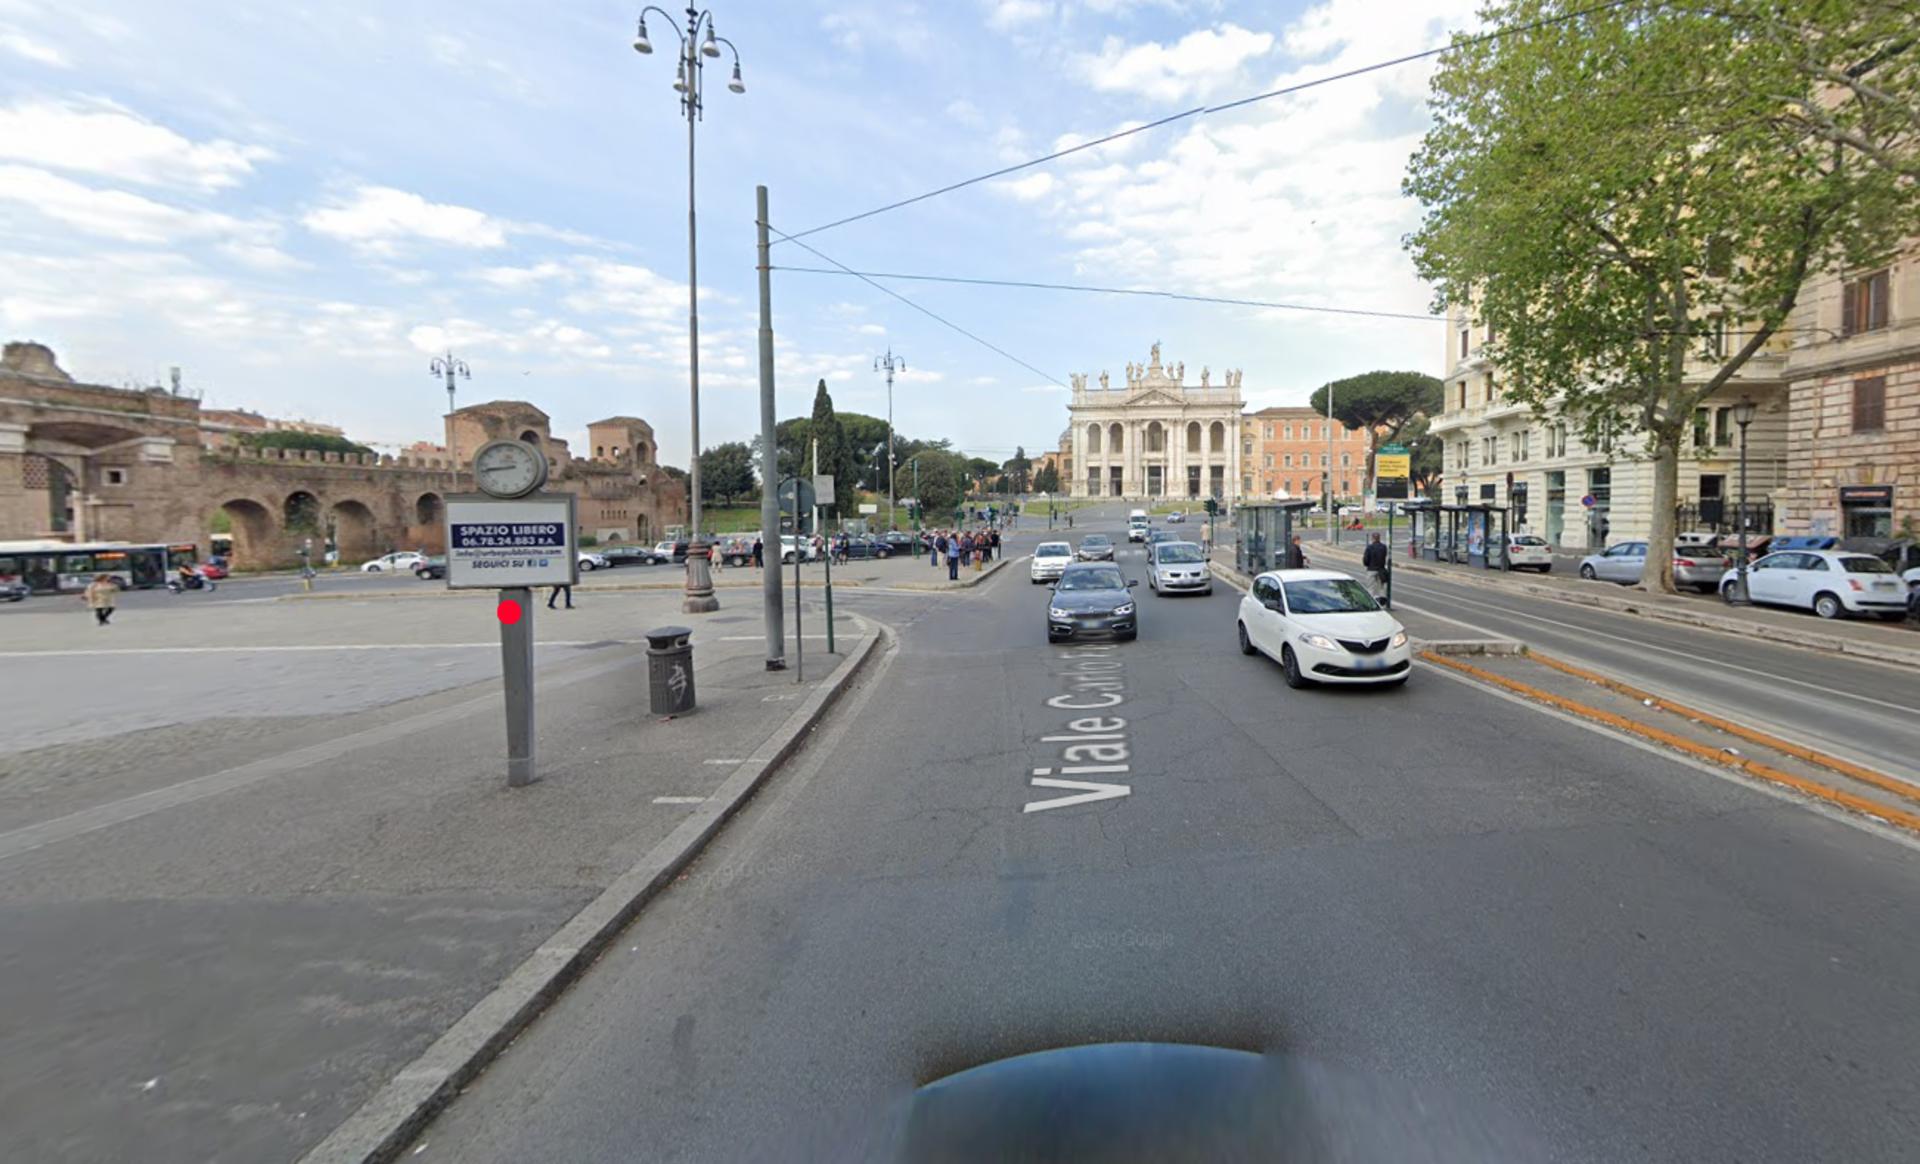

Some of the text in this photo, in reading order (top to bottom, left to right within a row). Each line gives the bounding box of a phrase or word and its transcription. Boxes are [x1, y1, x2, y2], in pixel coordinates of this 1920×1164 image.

[460, 525, 557, 536] SPAZIO LIBERO
[462, 536, 536, 546] 06.78.24.883
[472, 560, 525, 569] SEGUICI SU
